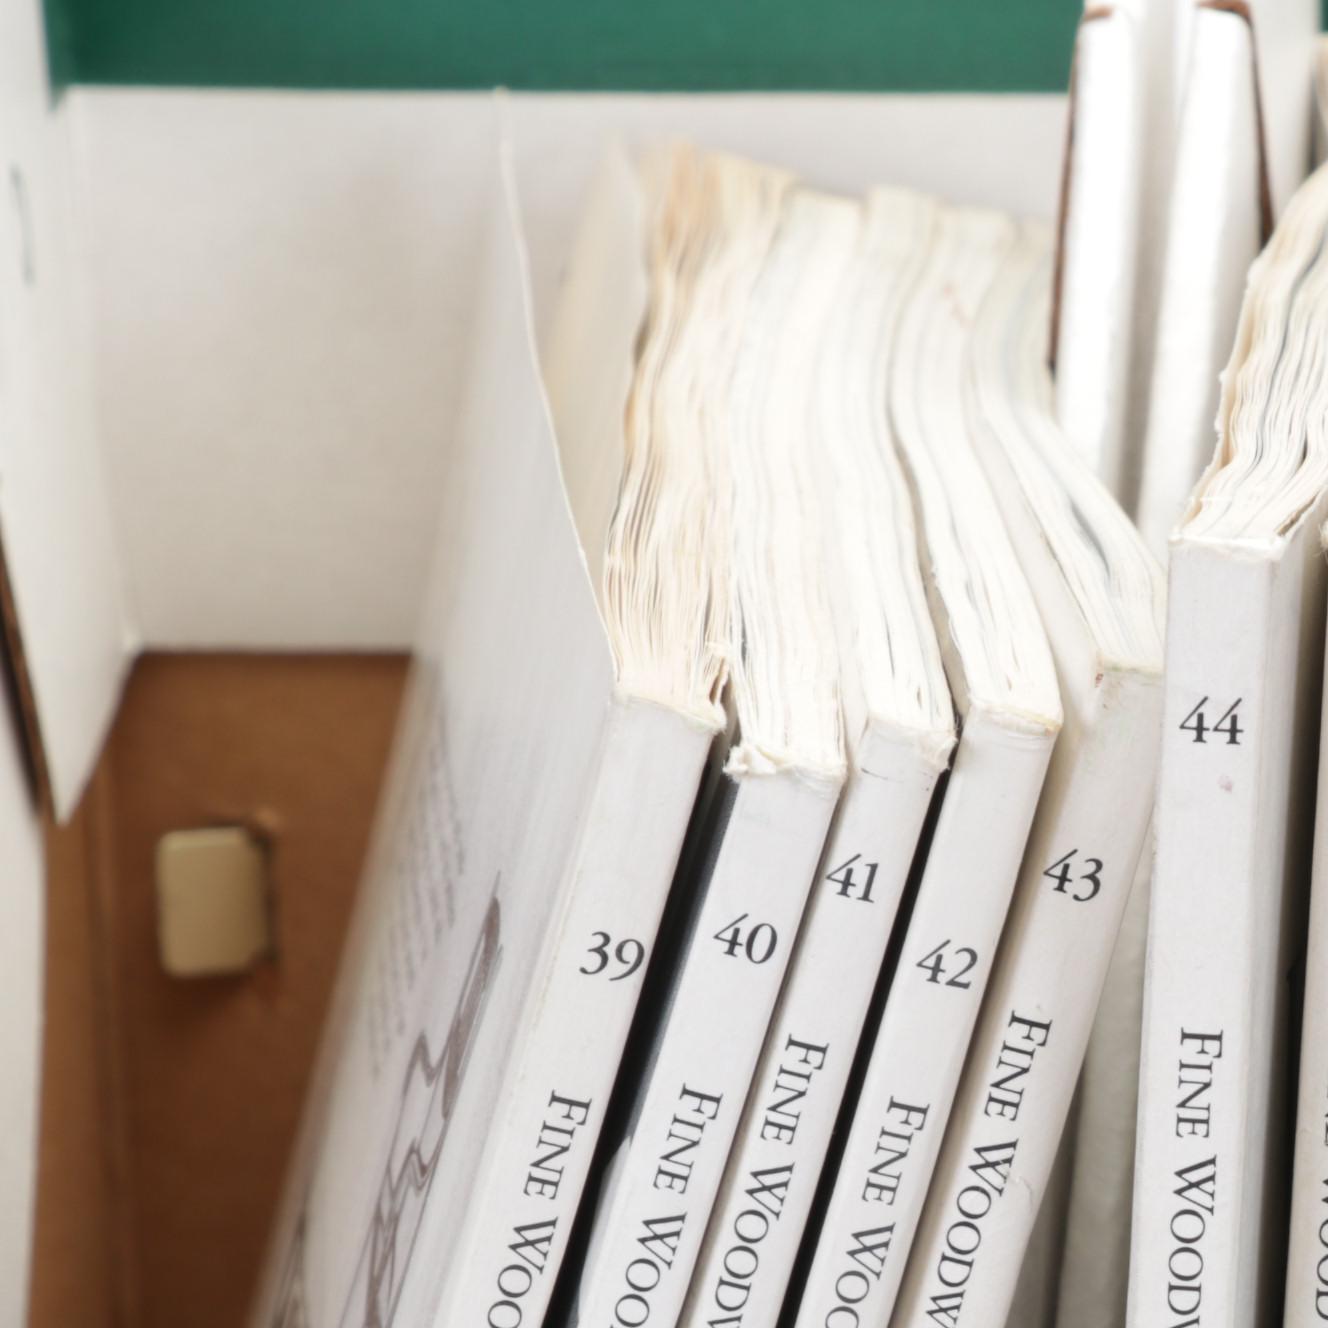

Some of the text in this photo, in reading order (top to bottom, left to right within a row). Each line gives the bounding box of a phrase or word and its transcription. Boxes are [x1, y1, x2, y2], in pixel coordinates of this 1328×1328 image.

[1179, 696, 1244, 745] 44
[825, 853, 878, 903] 41
[1042, 849, 1103, 902] 43
[579, 931, 645, 981] 39
[713, 913, 777, 964] 40
[916, 939, 978, 989] 42
[760, 1034, 829, 1145] FINE
[984, 1010, 1052, 1121] FINE
[1176, 1027, 1223, 1138] FINE
[523, 1090, 592, 1200] FINE
[653, 1083, 723, 1194] FINE
[862, 1096, 930, 1205] FINE
